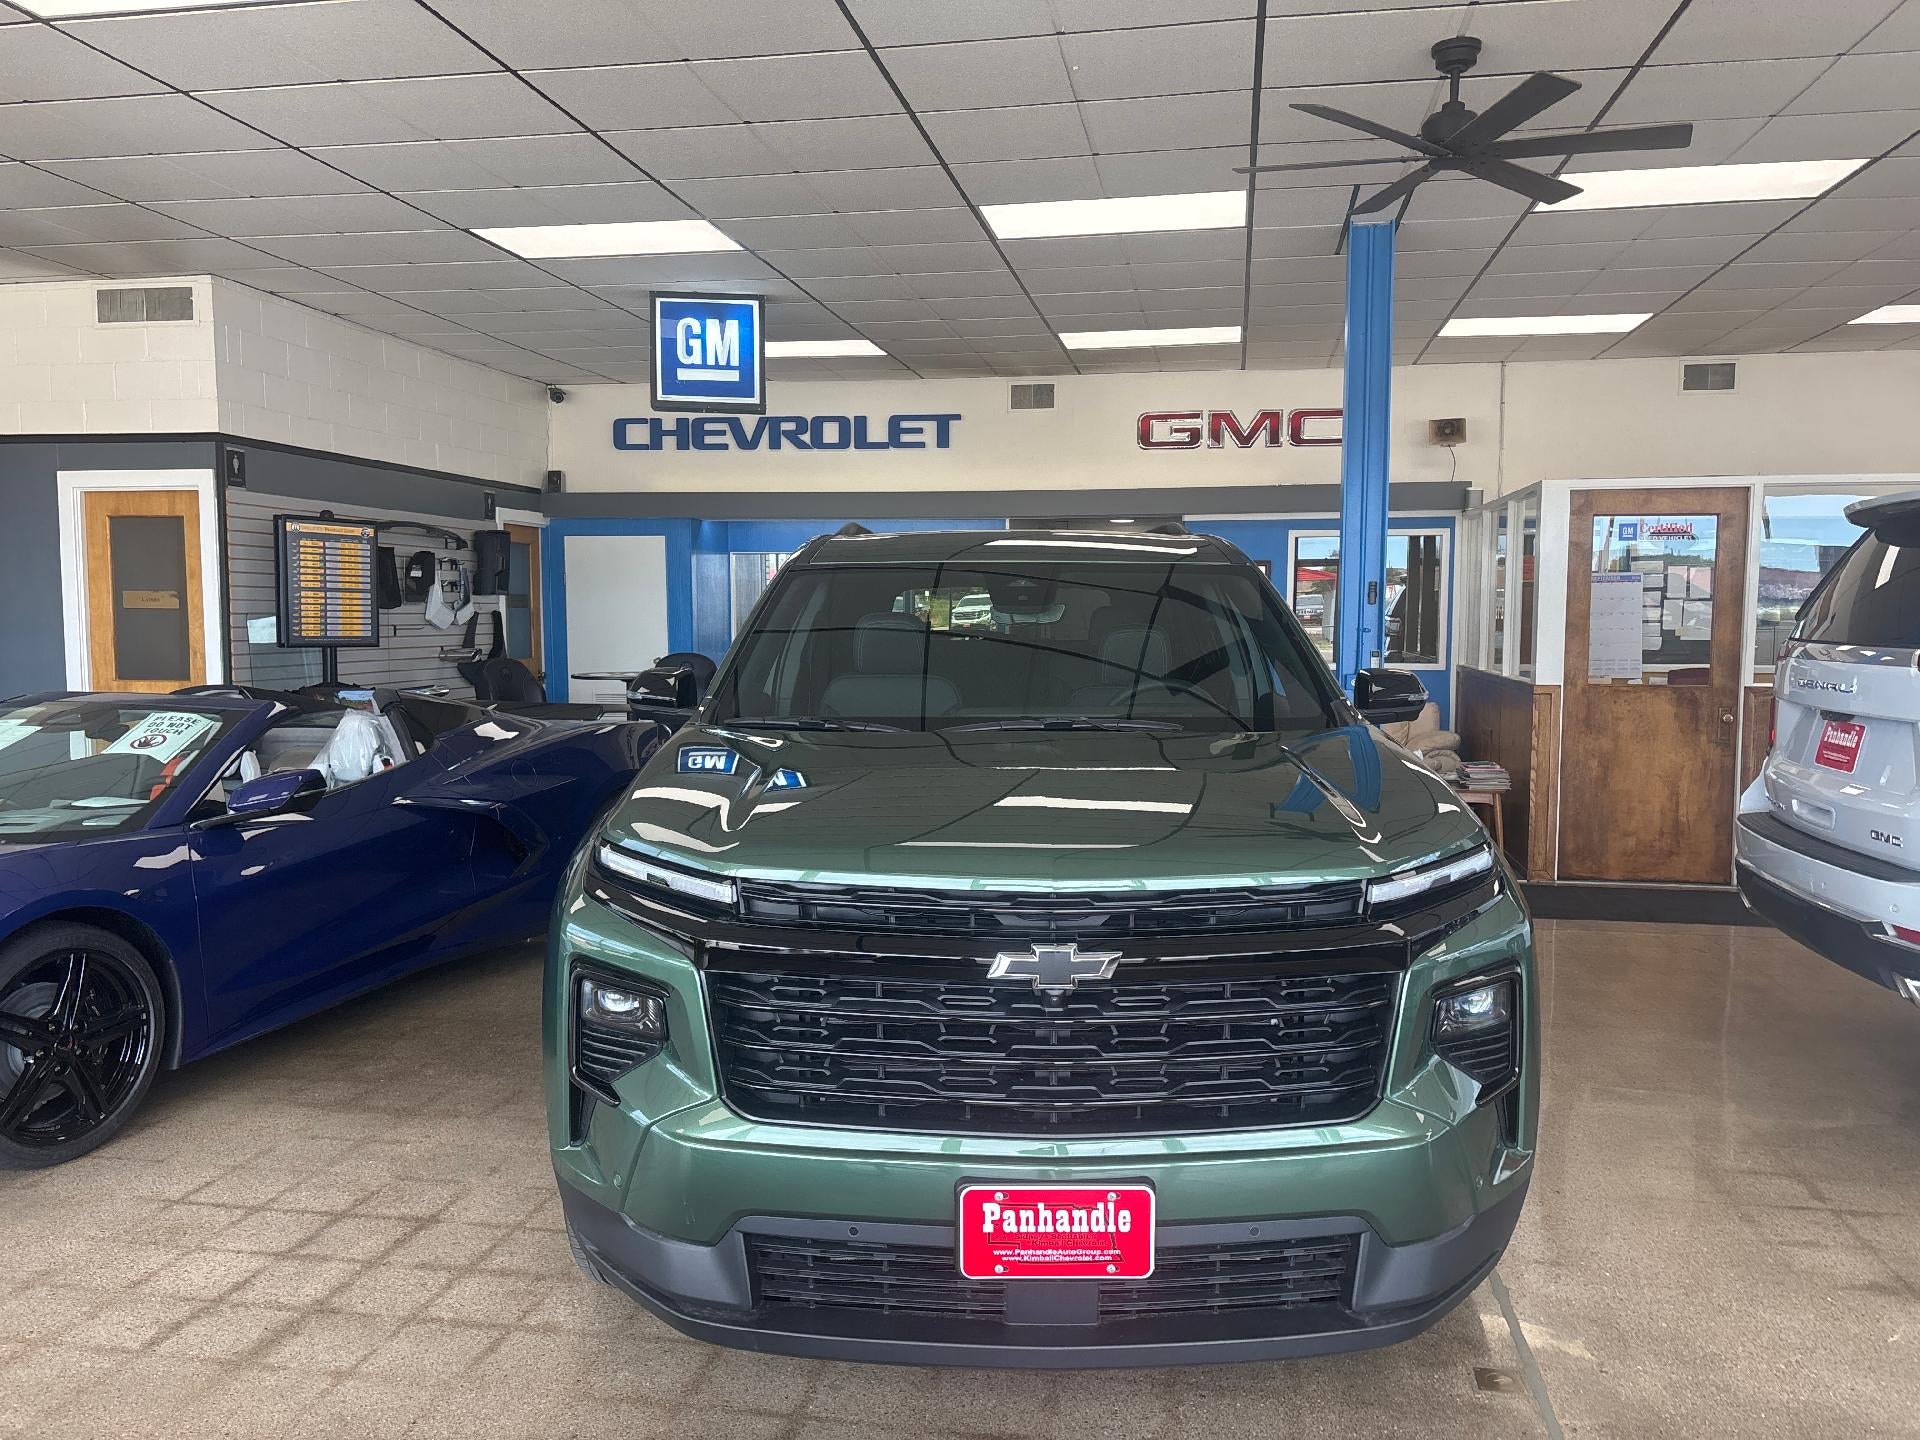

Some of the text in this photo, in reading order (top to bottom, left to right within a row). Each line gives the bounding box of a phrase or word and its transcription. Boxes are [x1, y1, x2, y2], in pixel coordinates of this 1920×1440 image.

[677, 317, 739, 367] GM
[613, 414, 962, 450] CHEVROLET
[1137, 408, 1343, 450] GMC
[1622, 526, 1633, 534] GM
[1640, 523, 1693, 534] Certified
[153, 715, 201, 725] PLEASE
[143, 727, 184, 736] TOUCH
[166, 722, 194, 730] NOT
[1870, 829, 1904, 848] GMC
[982, 1202, 1131, 1233] Panhandle
[993, 1248, 1121, 1256] www.PanhandleAutoGroup.com
